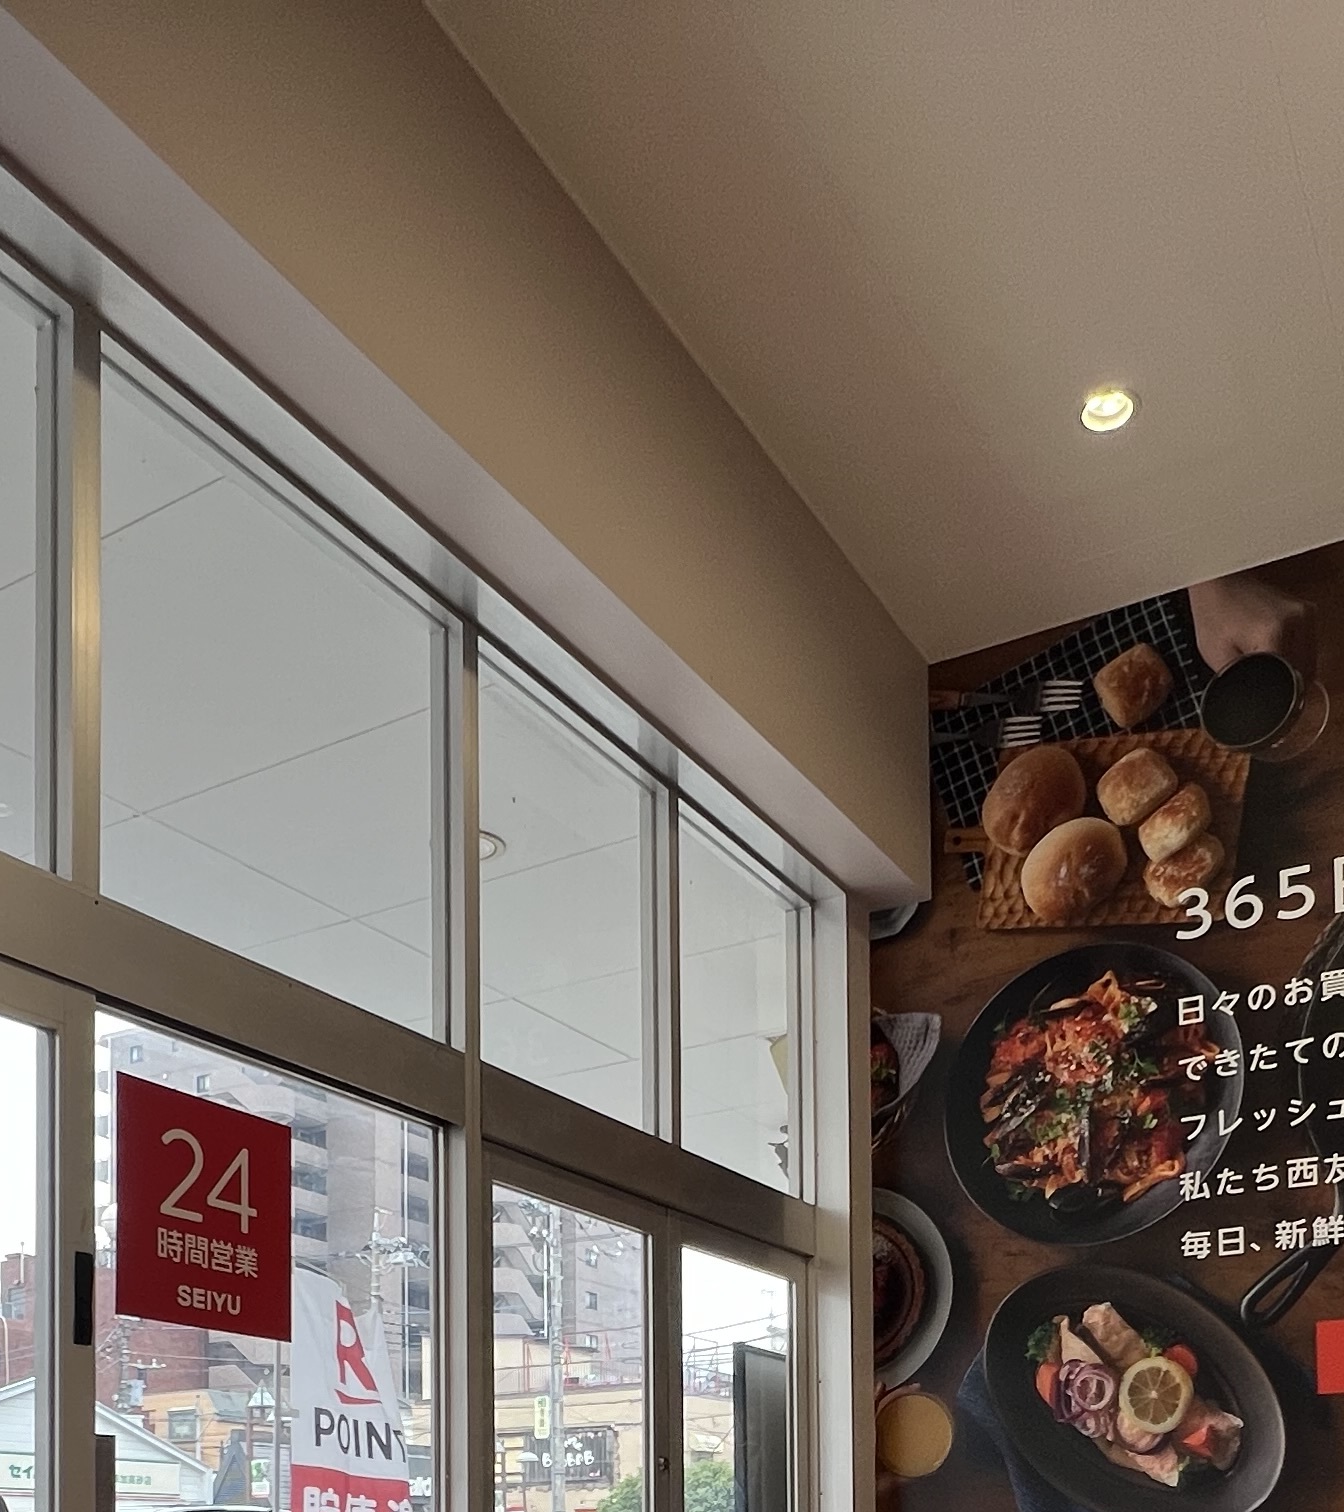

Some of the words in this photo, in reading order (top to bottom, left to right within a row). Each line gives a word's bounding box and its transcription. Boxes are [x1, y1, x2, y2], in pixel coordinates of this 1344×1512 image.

[159, 1127, 258, 1235] 24
[157, 1226, 259, 1279] 時間営業
[176, 1284, 241, 1316] SEIYU
